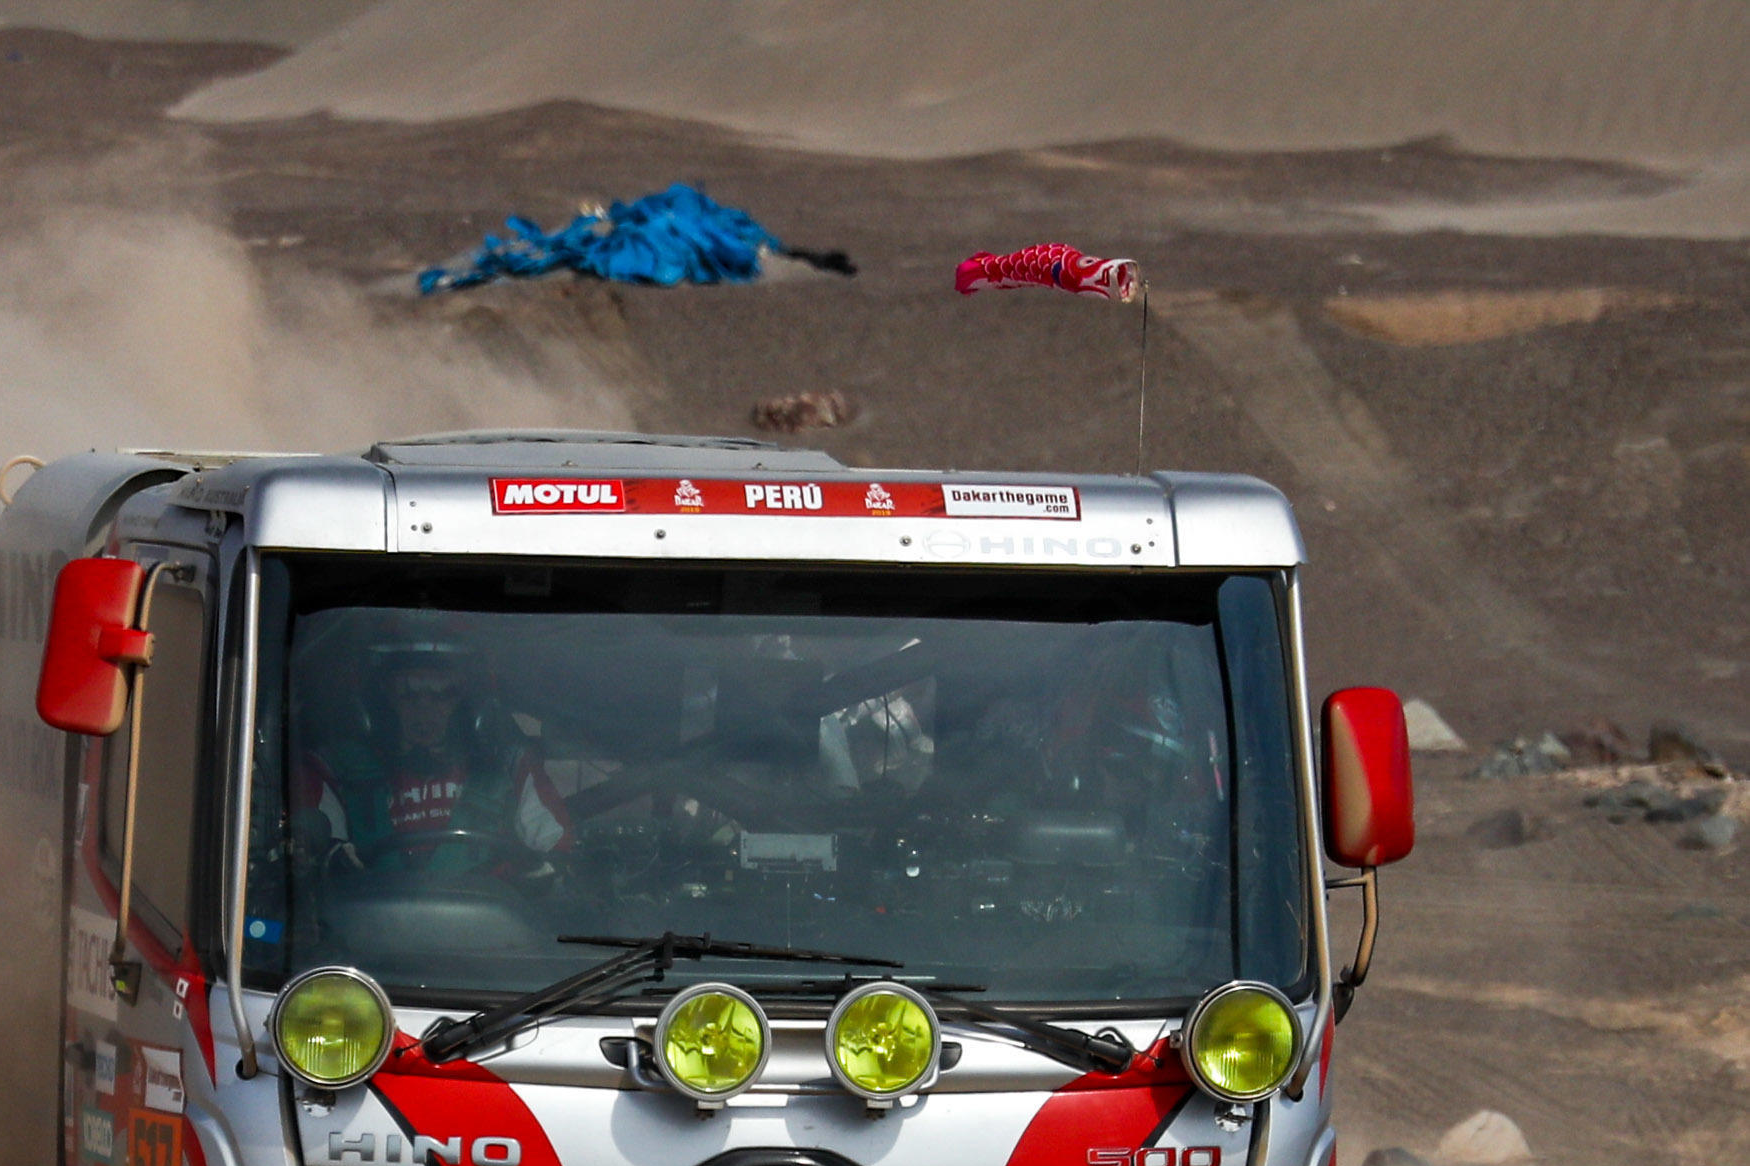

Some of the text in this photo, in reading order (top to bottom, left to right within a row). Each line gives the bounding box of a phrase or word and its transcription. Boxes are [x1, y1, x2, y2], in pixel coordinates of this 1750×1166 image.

[503, 484, 618, 504] MOTUL
[744, 483, 824, 509] PERÚ
[951, 490, 1068, 506] Dakarthegame
[1042, 504, 1070, 513] .com
[979, 536, 1123, 558] HINO
